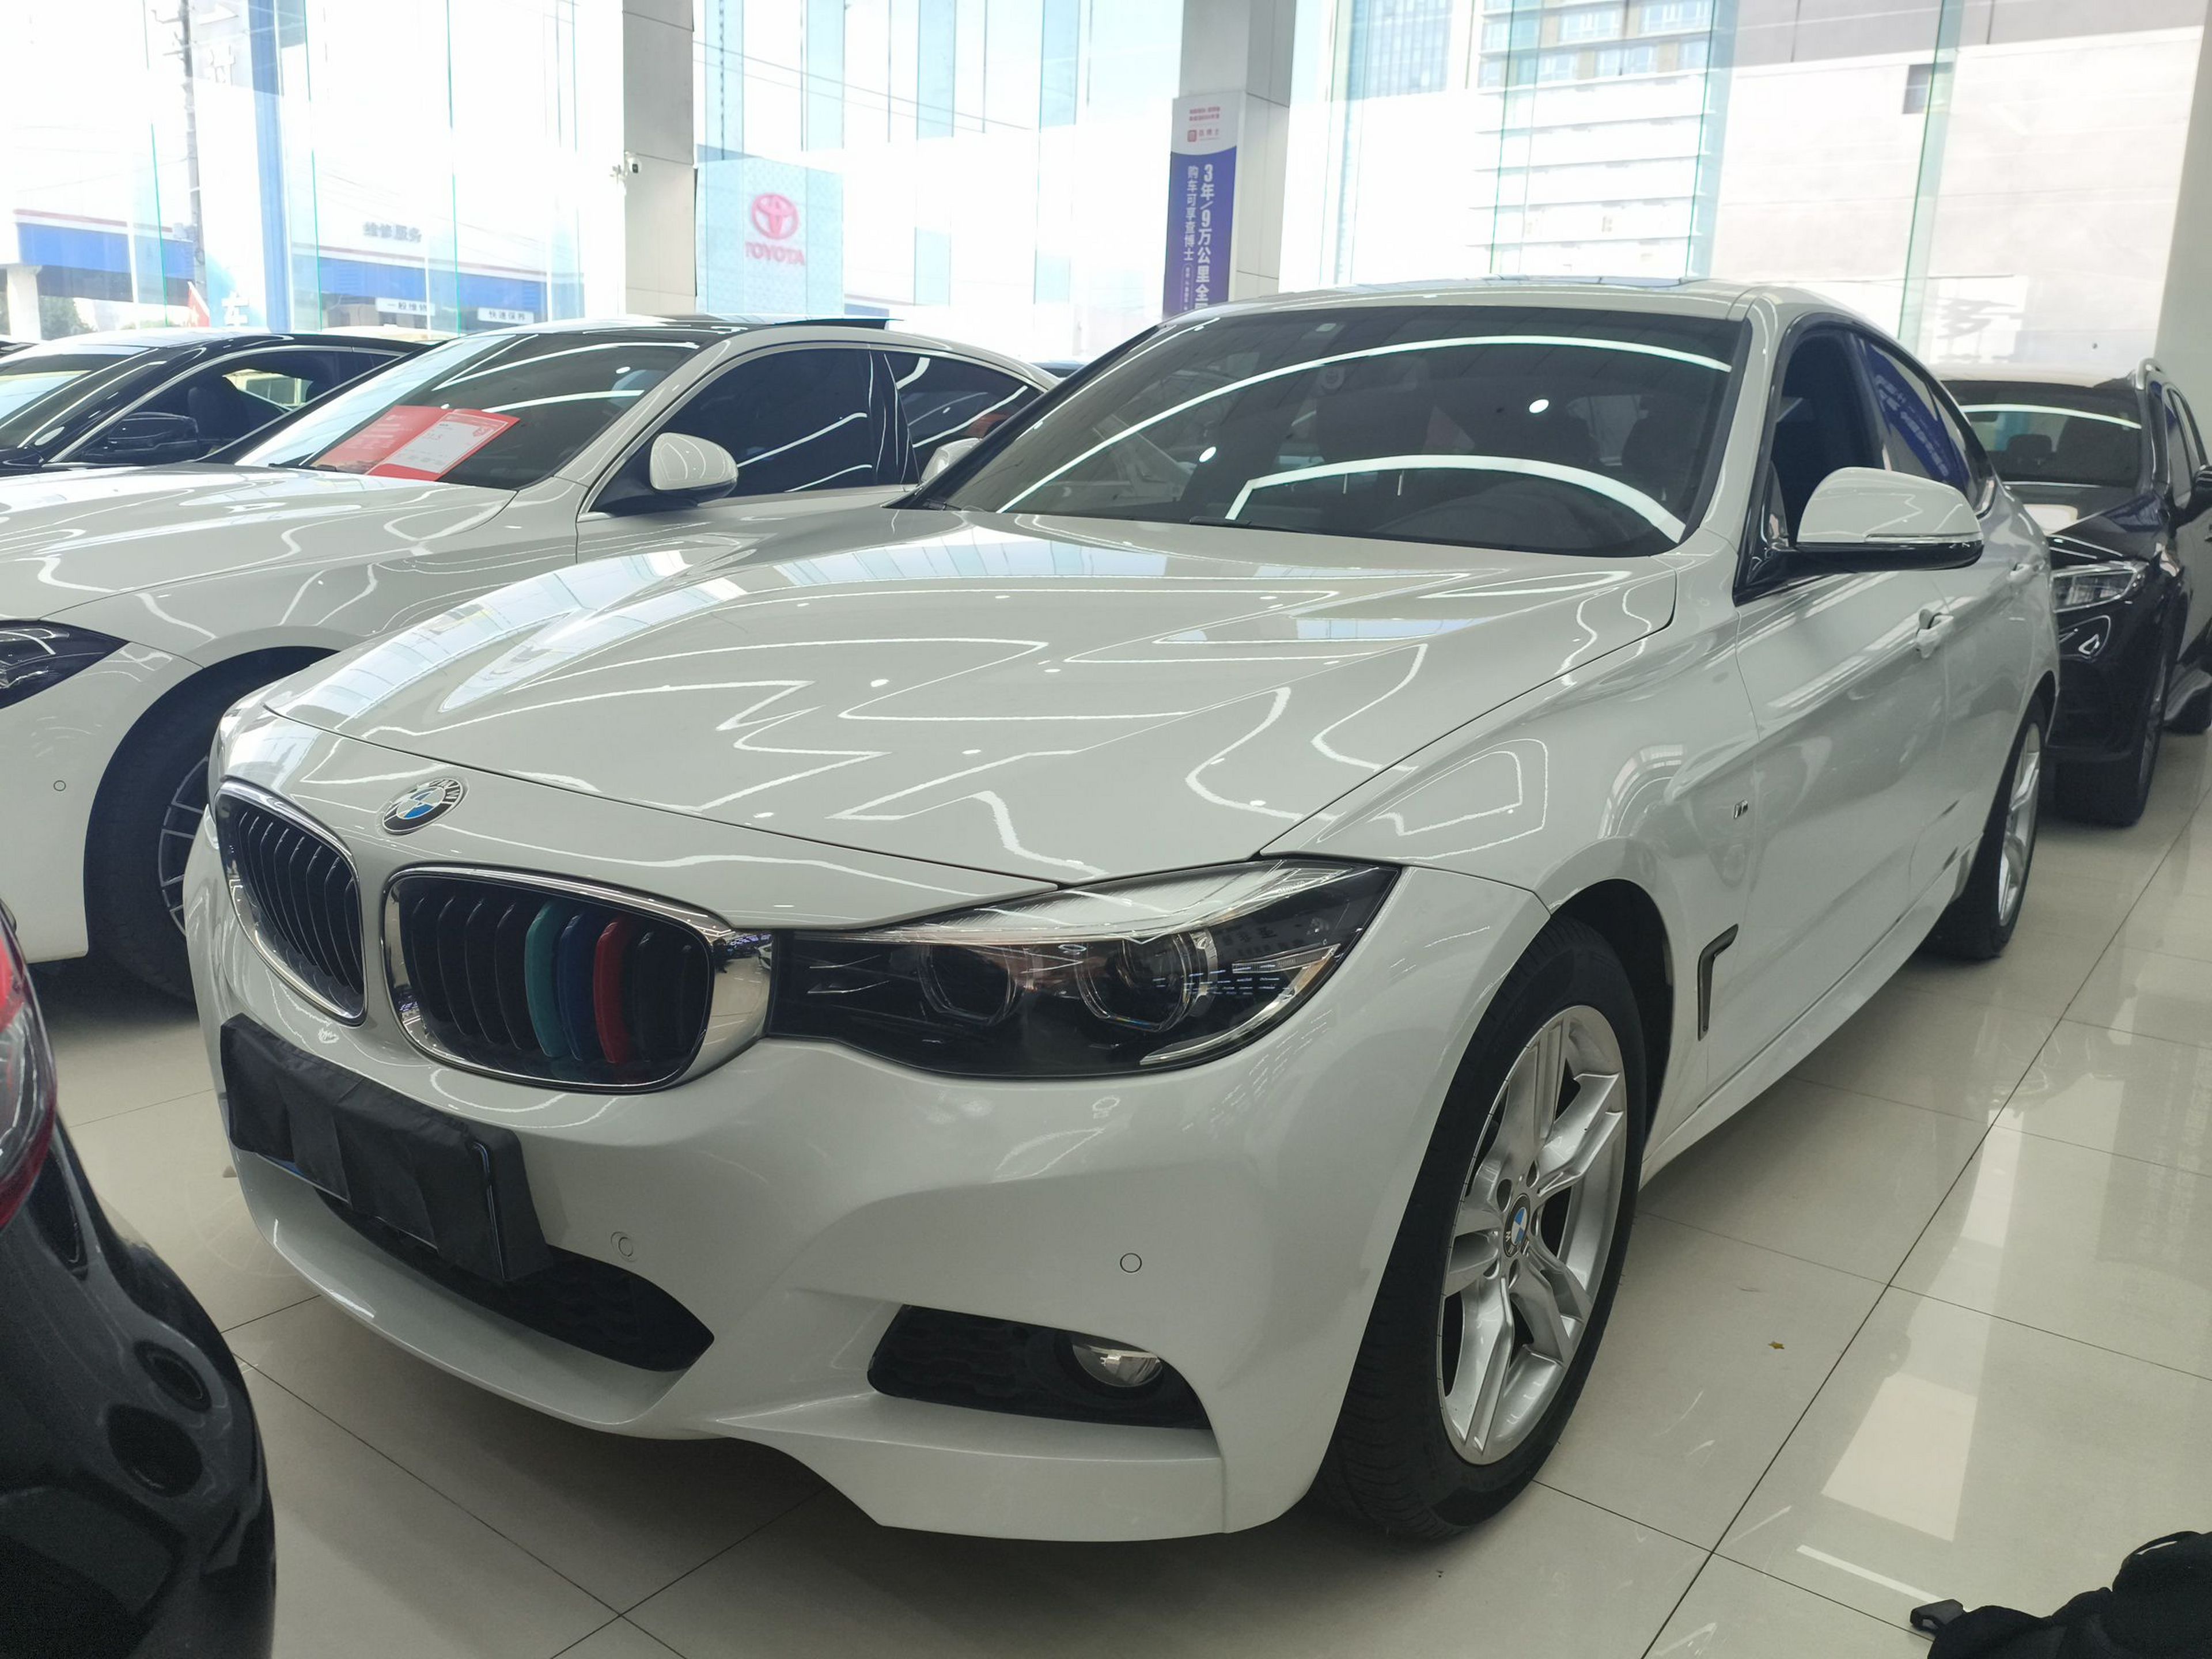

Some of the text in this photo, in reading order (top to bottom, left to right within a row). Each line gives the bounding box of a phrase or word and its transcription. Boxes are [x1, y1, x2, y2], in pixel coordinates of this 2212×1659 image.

[1183, 165, 1199, 261] 购车可享查博士
[745, 241, 805, 266] TOYOTA
